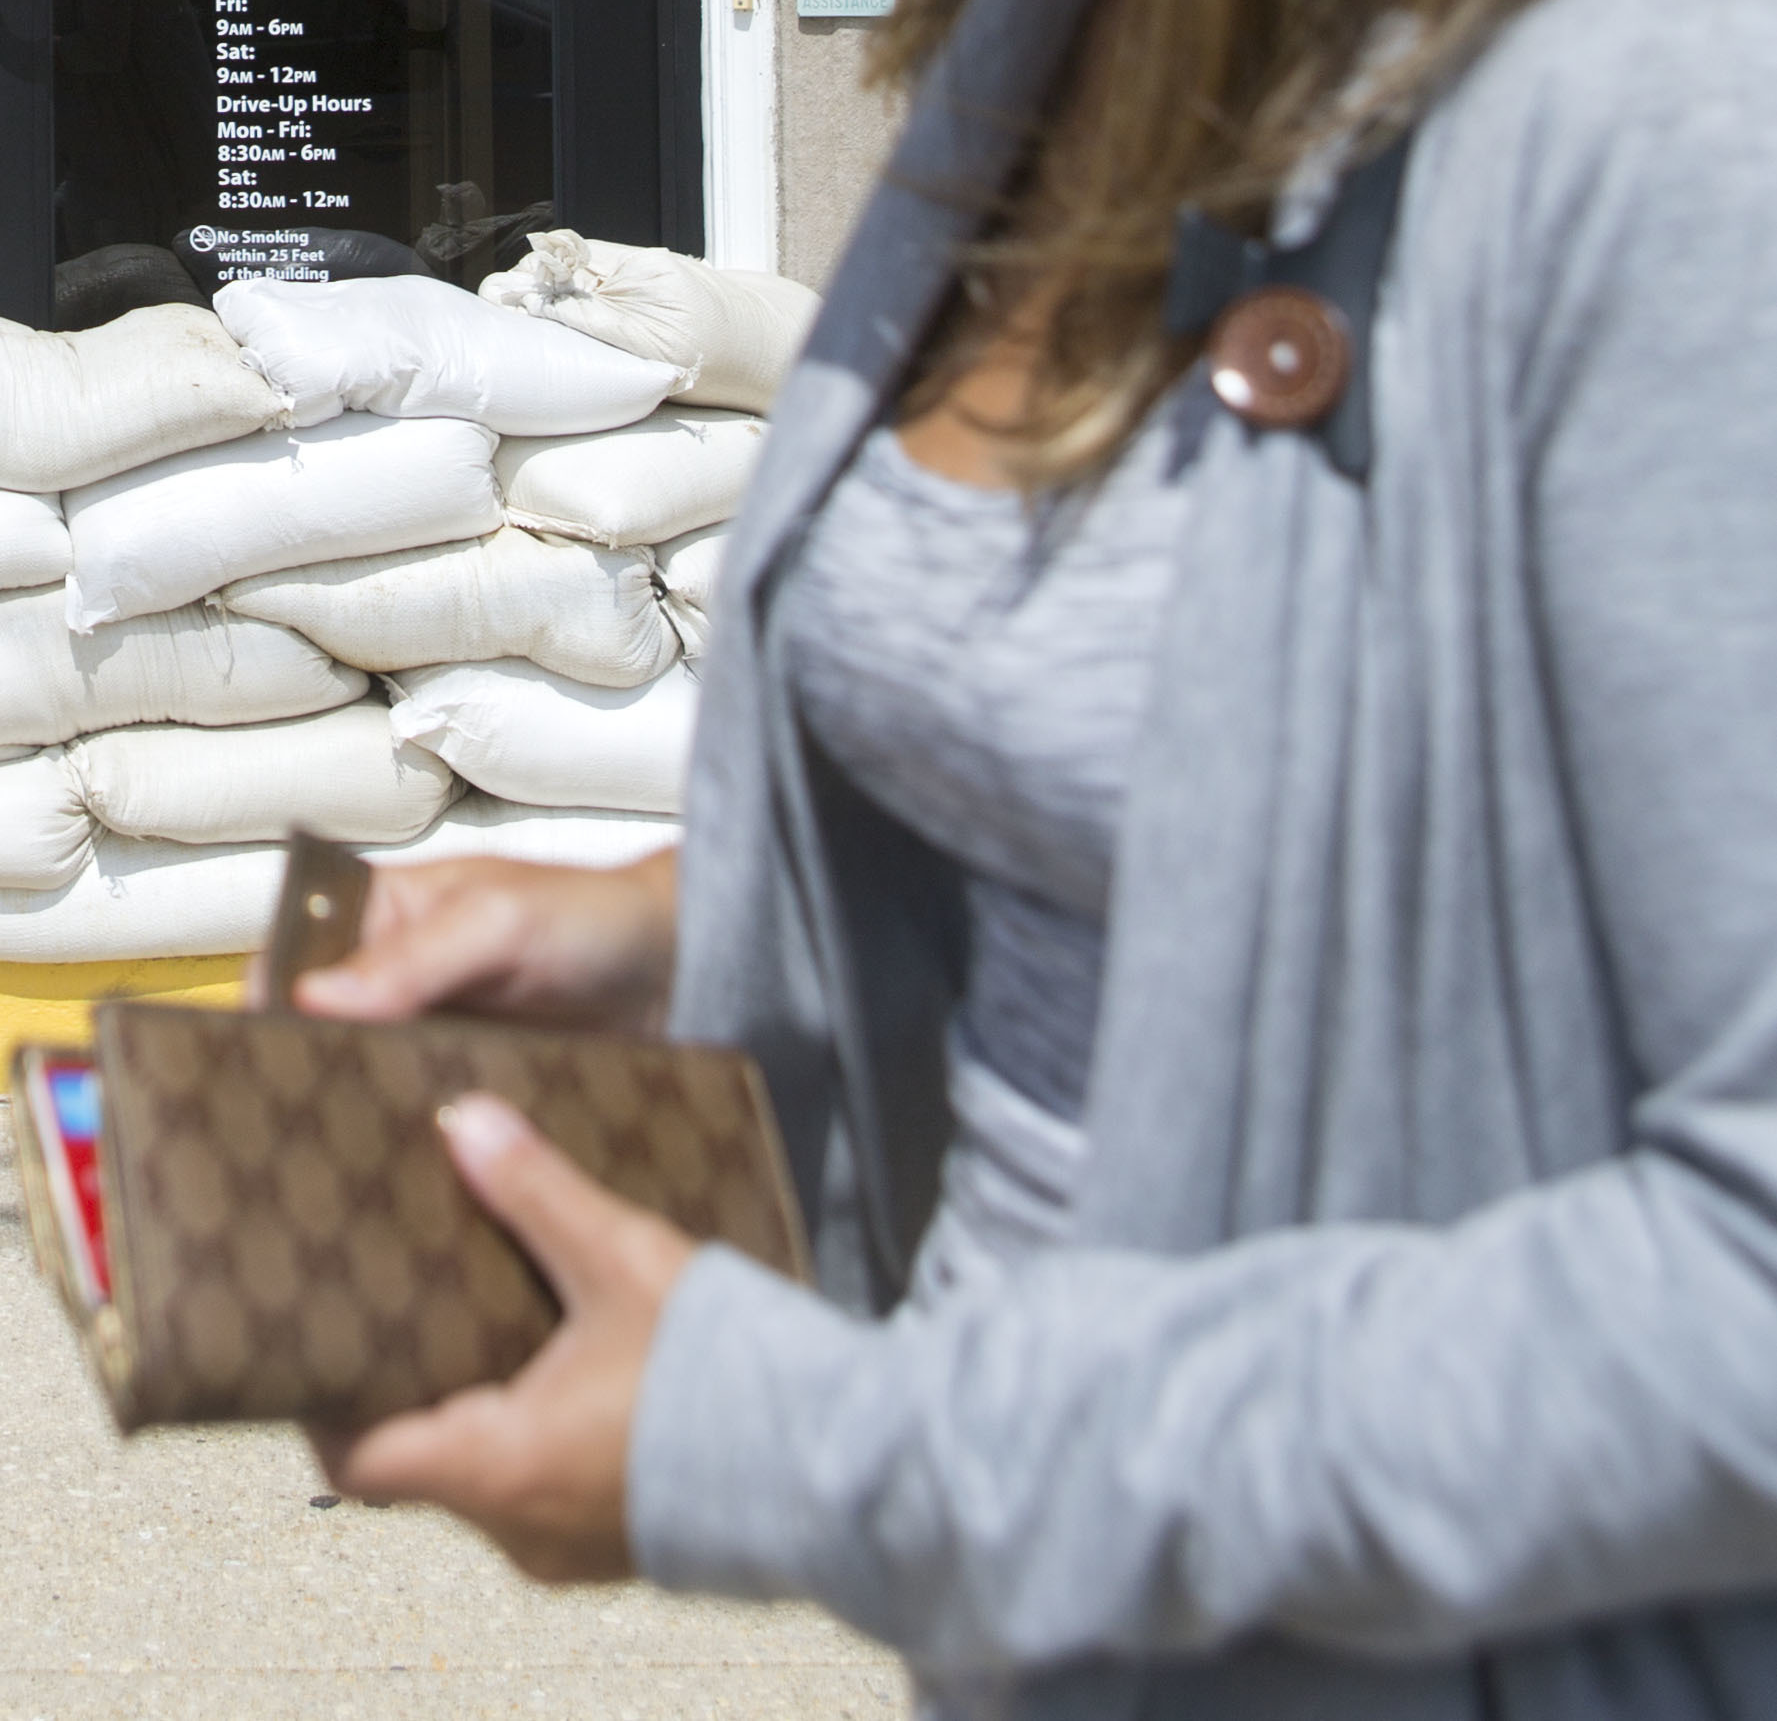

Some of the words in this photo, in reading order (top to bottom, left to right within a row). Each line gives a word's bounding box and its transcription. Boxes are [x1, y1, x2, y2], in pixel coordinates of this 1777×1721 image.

[216, 19, 252, 35] 9AM
[268, 19, 303, 35] 6PM
[217, 43, 255, 59] Sat:
[217, 67, 253, 83] 9AM
[270, 67, 316, 83] 12PM
[217, 95, 307, 115] Drive-Up
[313, 95, 371, 111] Hours
[218, 122, 262, 138] Mon
[279, 121, 311, 138] Fri:
[218, 145, 285, 161] 8:30AM
[301, 144, 335, 160] 6PM
[219, 169, 256, 185] Sat:
[219, 192, 285, 208] 8:30AM
[303, 191, 349, 207] 12PM
[217, 231, 239, 243] No
[242, 230, 309, 246] Smoking
[218, 249, 266, 262] within
[270, 249, 288, 261] 25
[291, 249, 324, 262] Feet
[218, 267, 235, 280] of
[236, 267, 263, 279] the
[265, 267, 329, 282] Building
